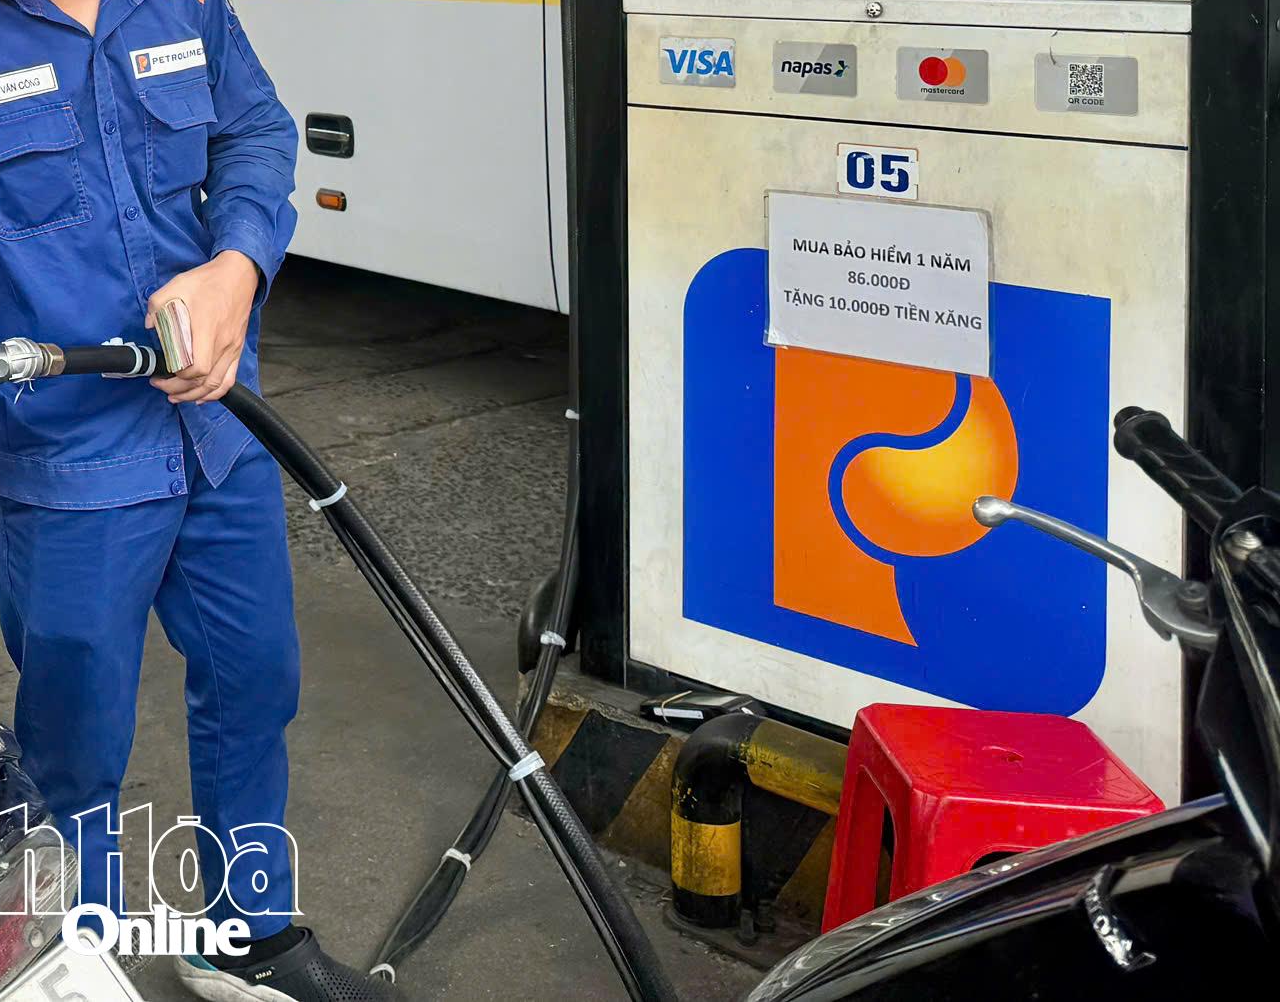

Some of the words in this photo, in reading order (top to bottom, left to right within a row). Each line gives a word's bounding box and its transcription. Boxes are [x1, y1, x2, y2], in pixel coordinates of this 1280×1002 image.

[662, 48, 734, 76] VISA
[781, 60, 832, 78] napas
[920, 87, 965, 96] mastercard
[1068, 97, 1080, 105] QR
[1081, 98, 1105, 106] CODE
[846, 151, 910, 193] 05
[792, 238, 830, 255] MUA
[833, 240, 866, 259] BẢO
[871, 245, 912, 265] HIỂM
[917, 254, 925, 267] 1
[930, 253, 971, 272] NĂM
[847, 270, 911, 291] 86.000Đ
[784, 289, 825, 307] TẶNG
[829, 296, 890, 316] 10.000Đ
[895, 302, 930, 323] TIỀN
[934, 310, 983, 330] XĂNG
